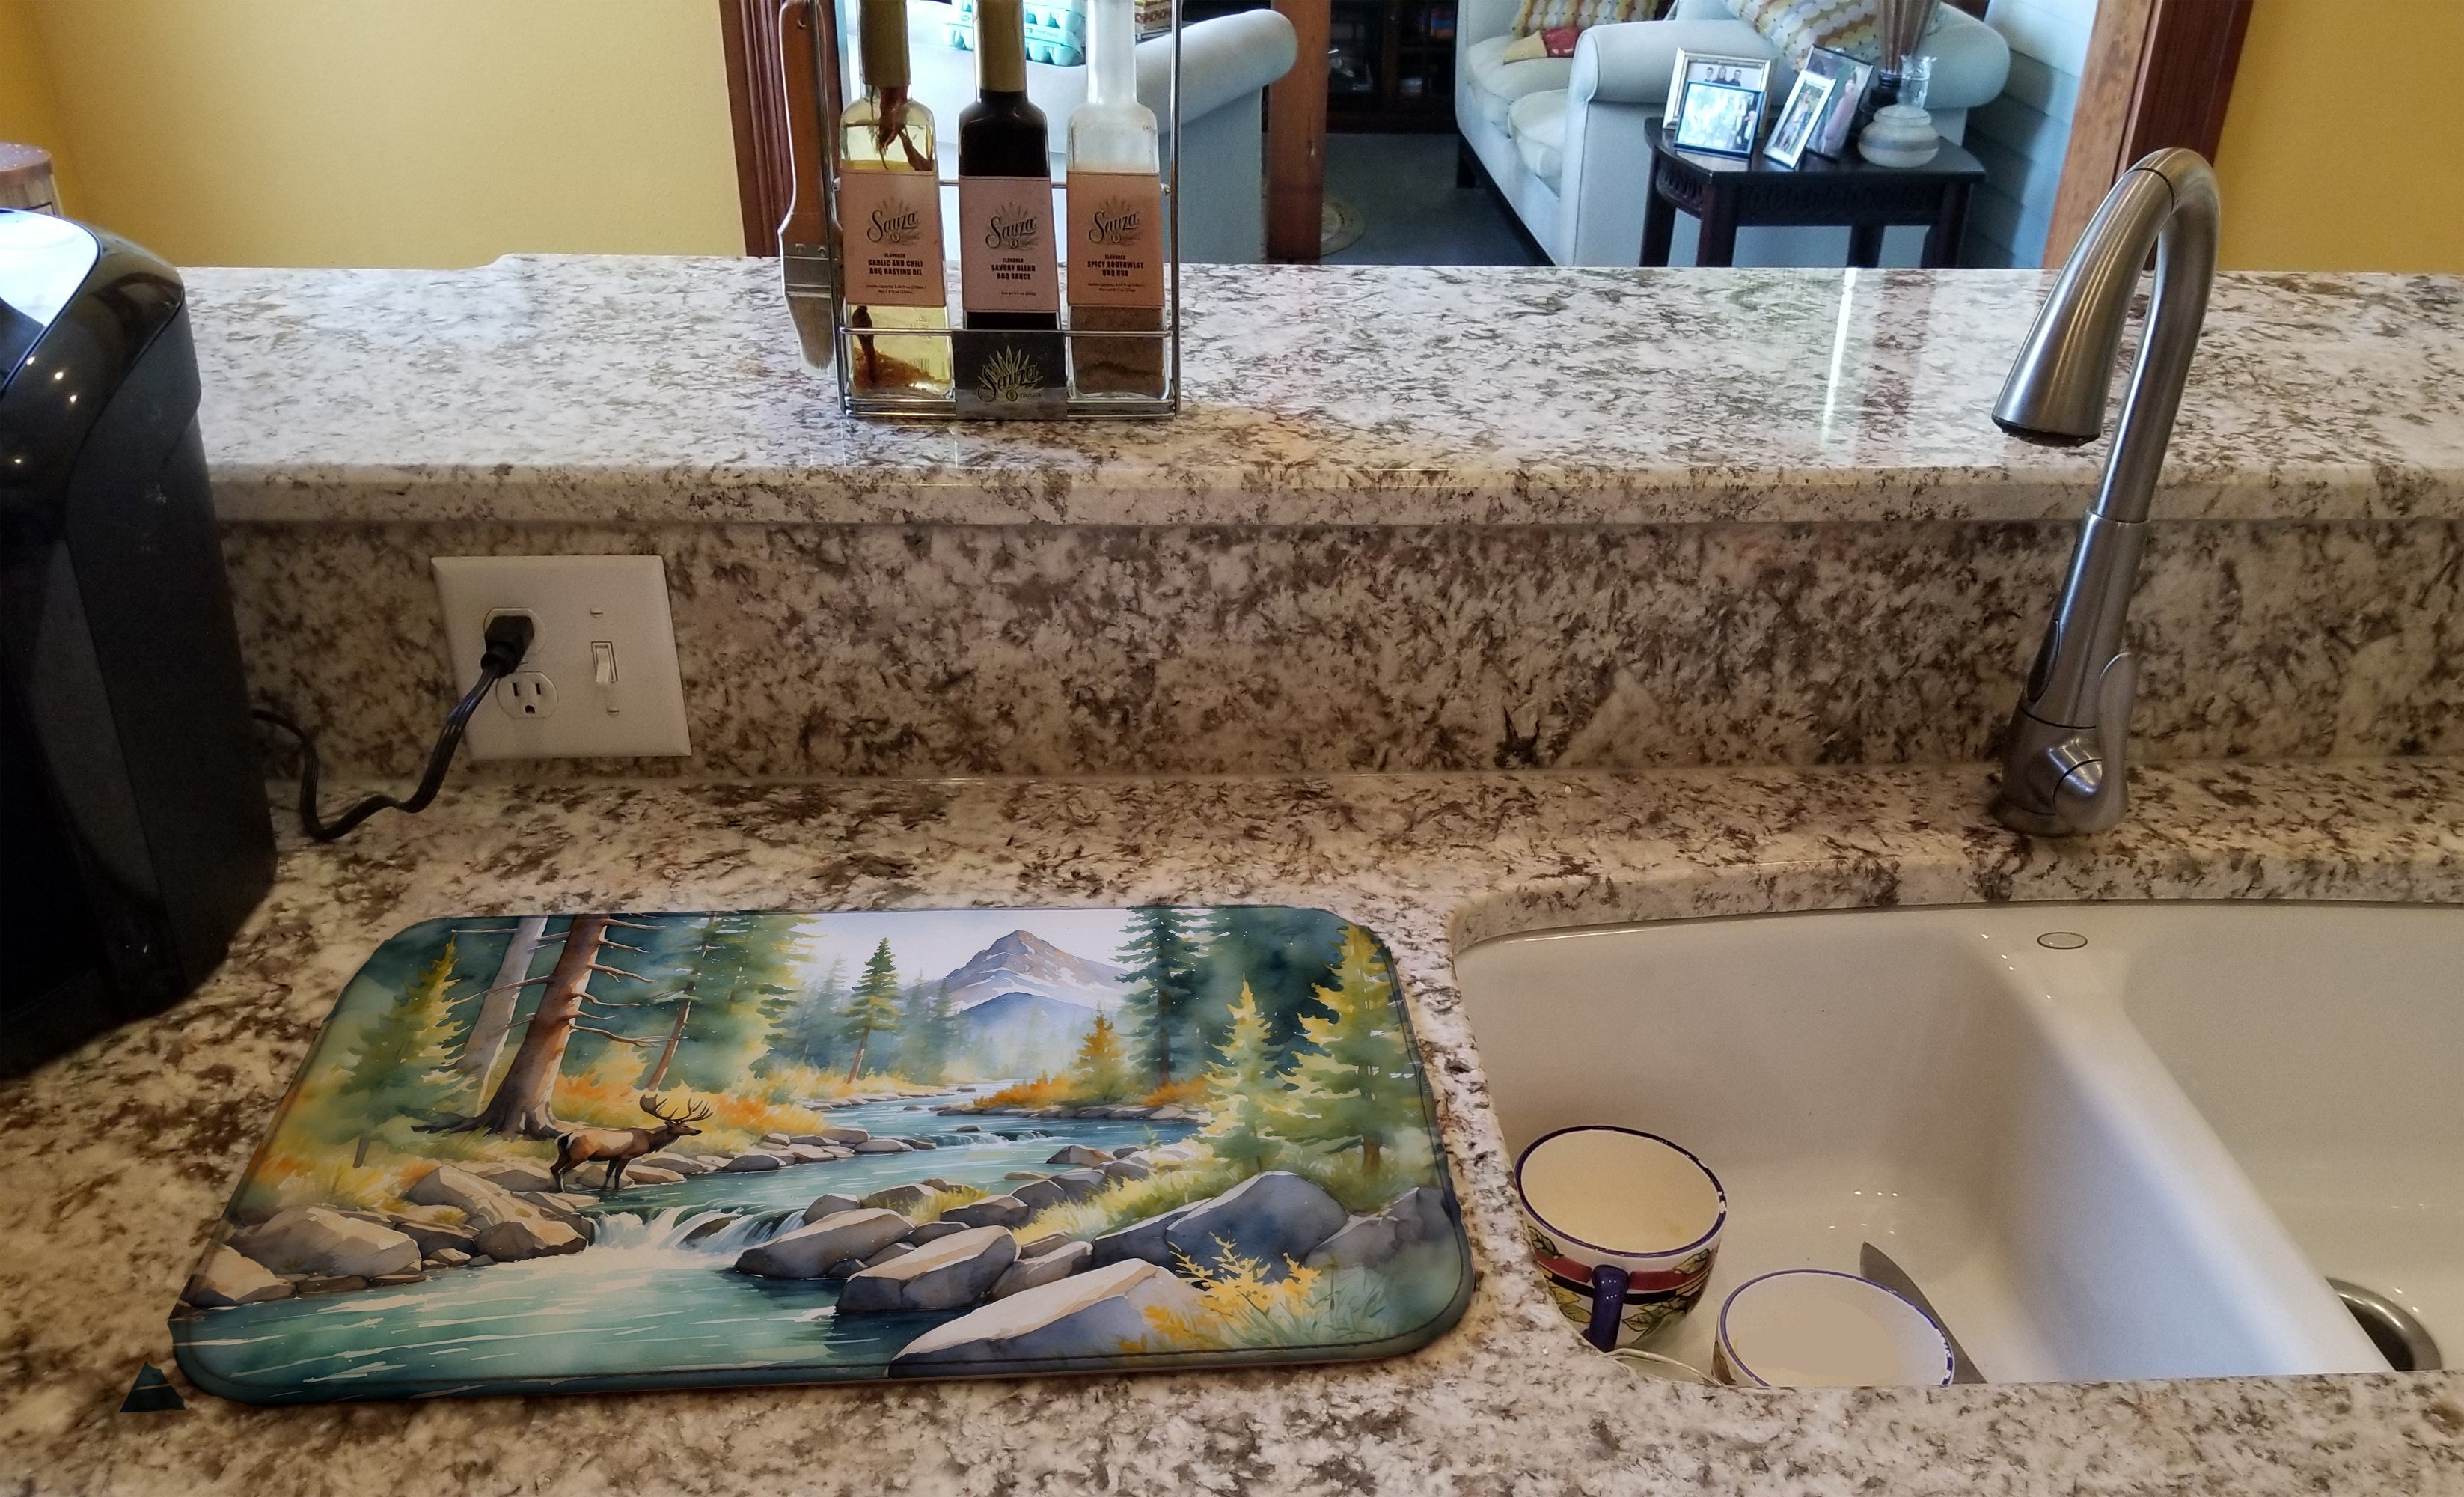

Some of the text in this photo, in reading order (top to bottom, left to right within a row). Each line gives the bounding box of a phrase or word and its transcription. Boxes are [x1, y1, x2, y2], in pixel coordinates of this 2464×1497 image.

[866, 210, 920, 243] Sauza
[985, 216, 1037, 249] Sauza
[1089, 211, 1140, 244] Sauza
[869, 267, 882, 275] BBQ
[977, 363, 1039, 403] Sauza
